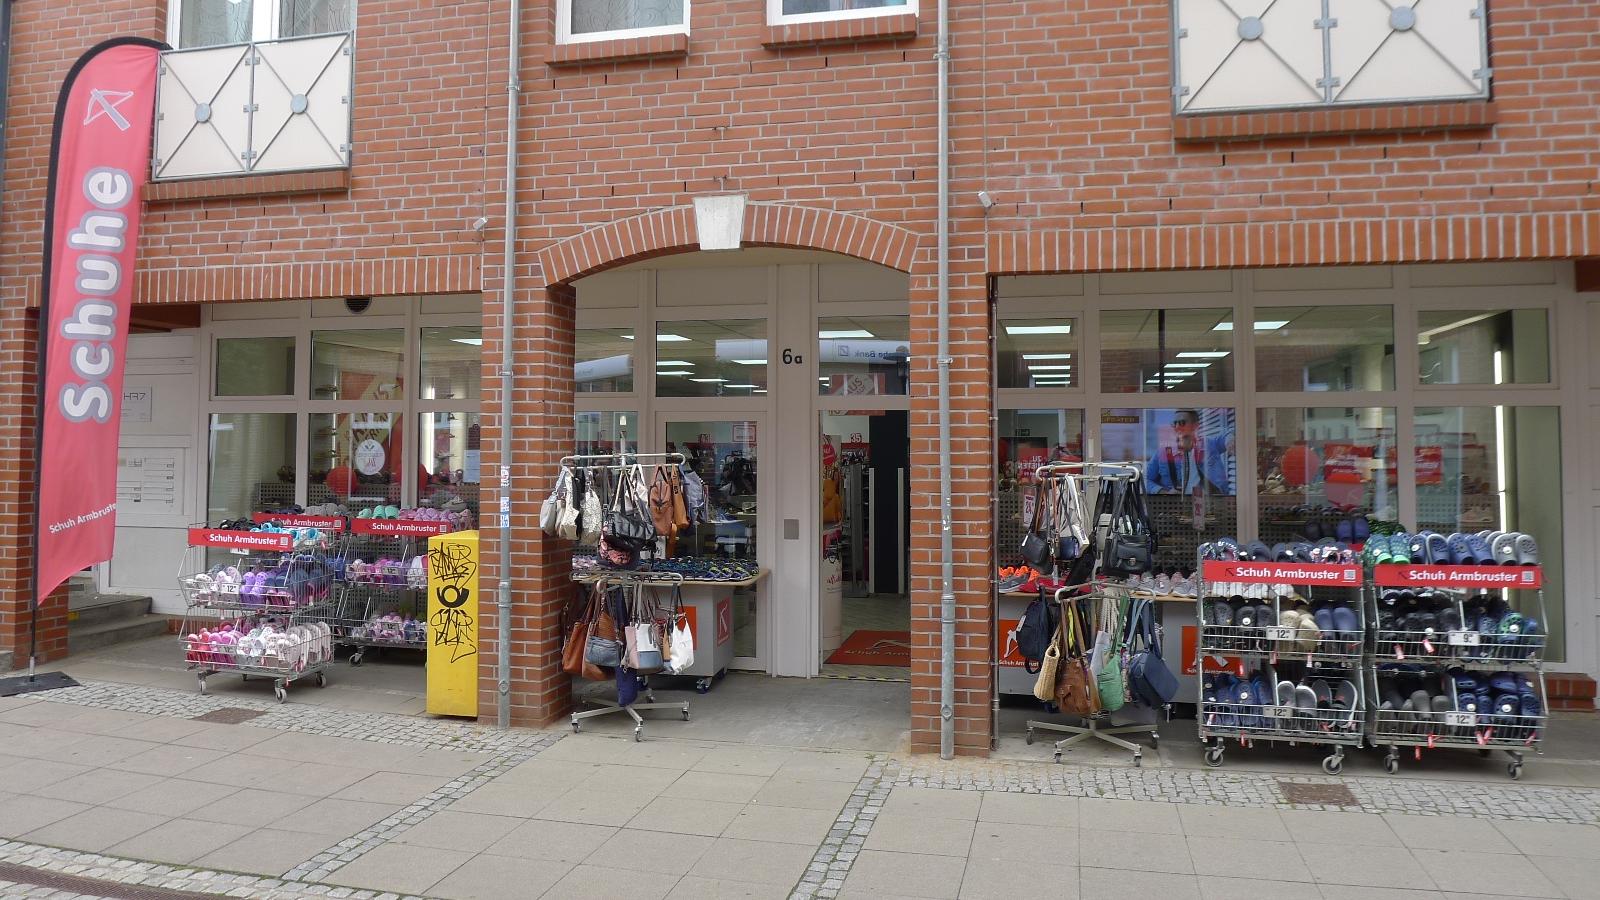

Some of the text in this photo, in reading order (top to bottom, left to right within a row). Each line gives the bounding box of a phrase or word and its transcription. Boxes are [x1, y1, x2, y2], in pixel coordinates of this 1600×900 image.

[62, 169, 130, 421] Schuhe
[782, 348, 802, 364] 6a
[850, 433, 862, 443] 35
[49, 518, 76, 534] Schuh
[293, 519, 333, 528] Armbruster
[372, 522, 437, 533] Schuh Armbruster
[209, 533, 278, 546] Schuh Armbruster
[1236, 567, 1340, 580] Schuh Armbruster
[1409, 570, 1518, 582] Schuh Armbruster
